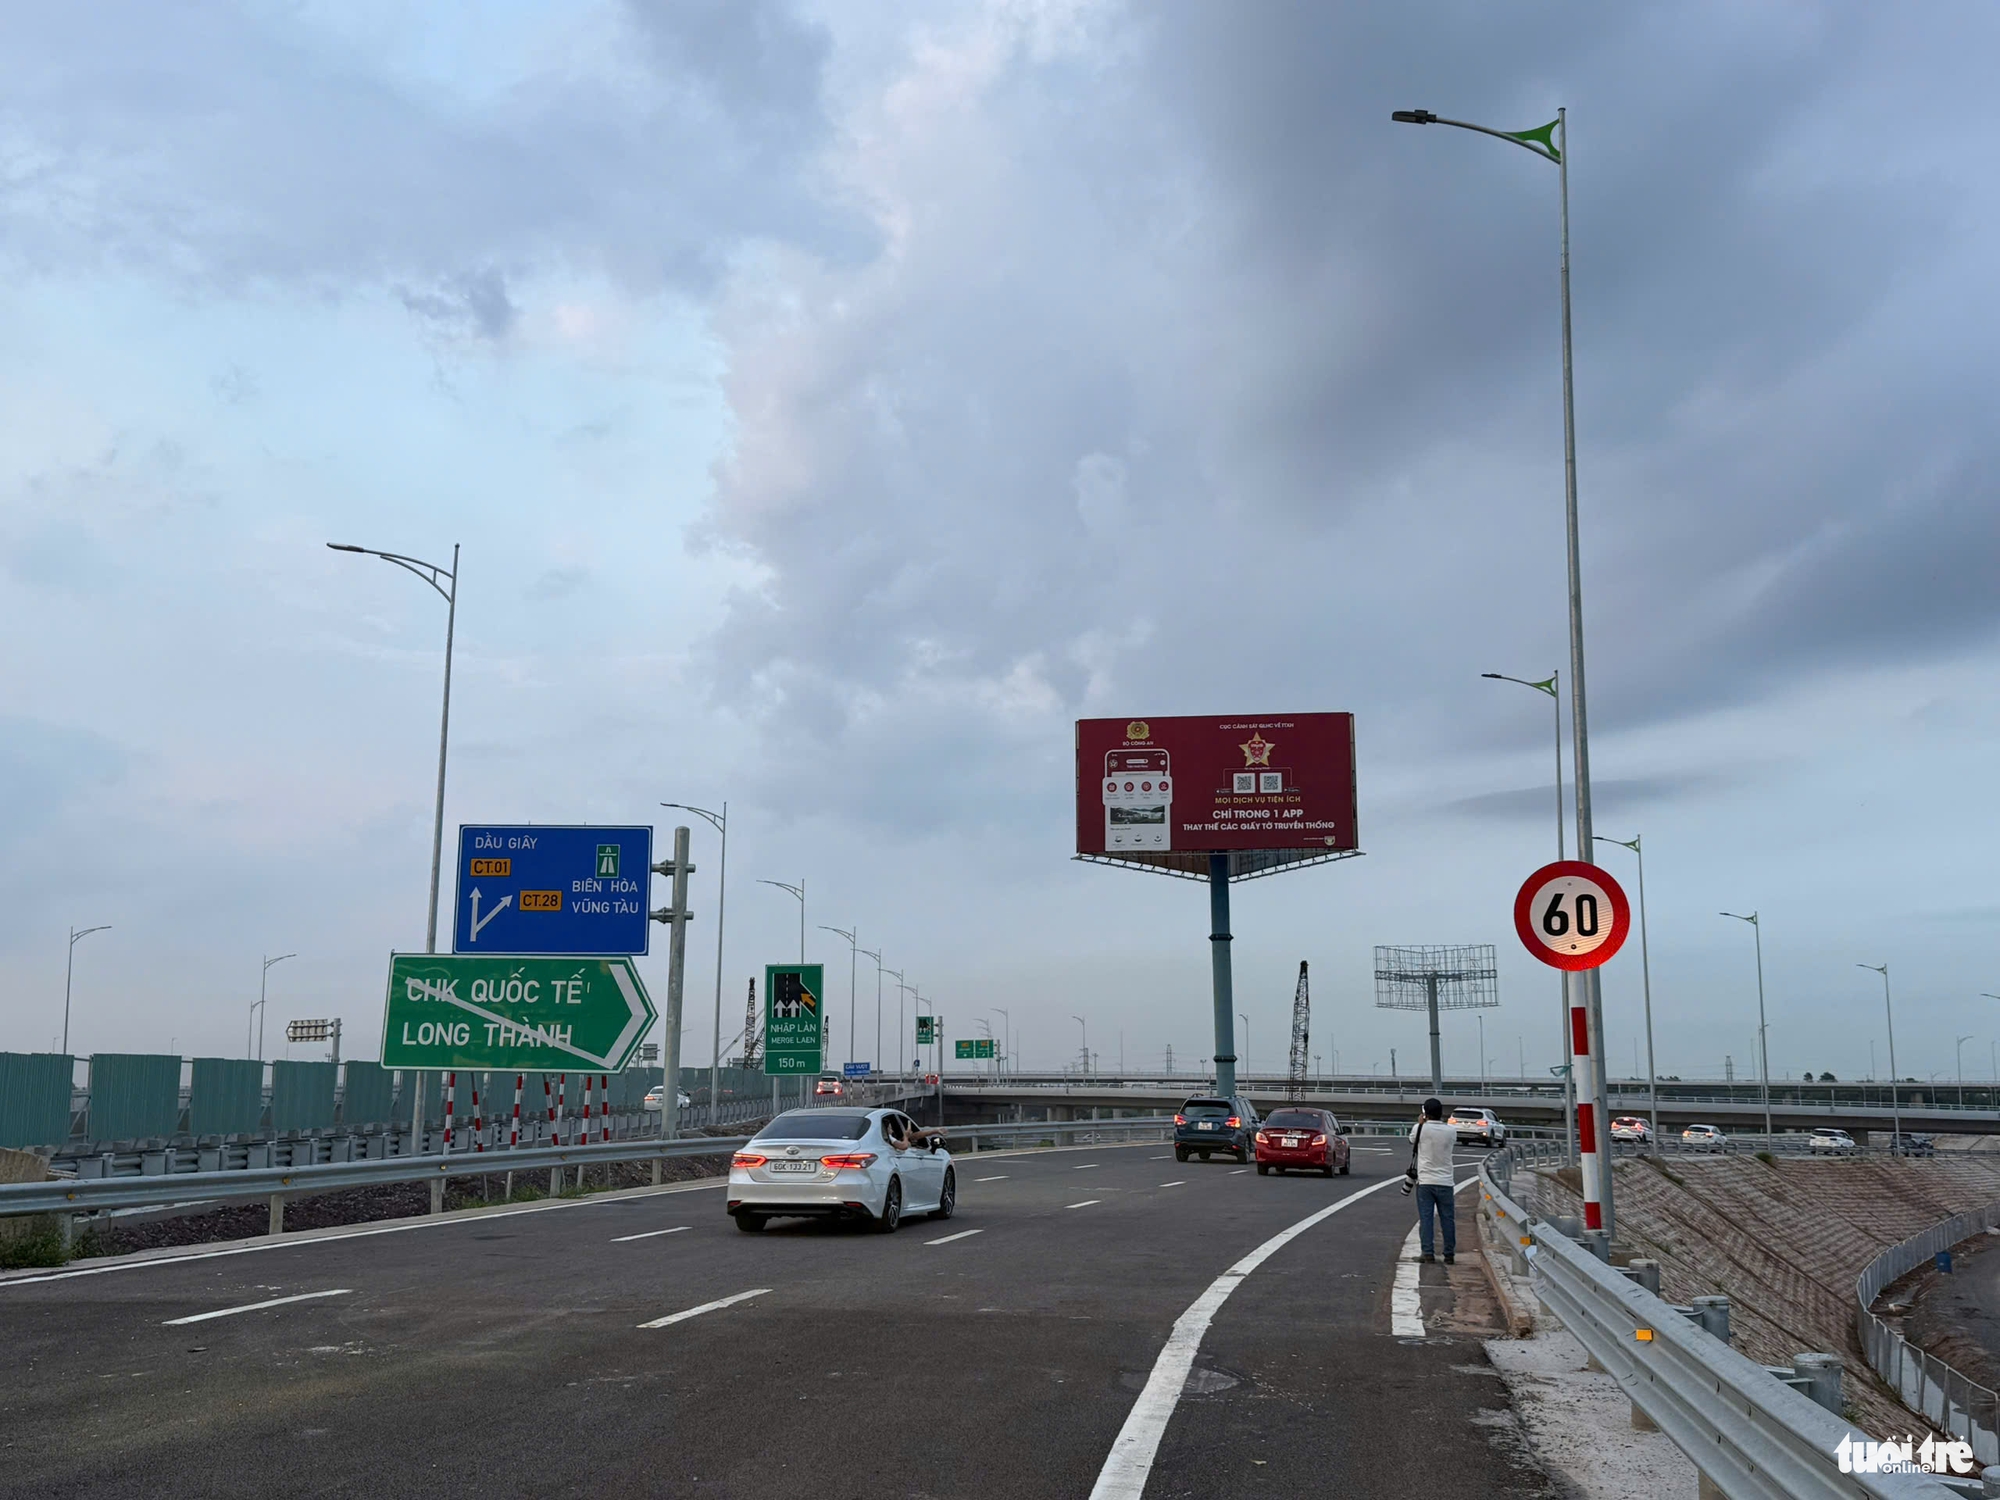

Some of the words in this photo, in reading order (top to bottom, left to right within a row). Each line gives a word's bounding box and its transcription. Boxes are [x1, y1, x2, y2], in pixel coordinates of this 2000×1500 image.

[1215, 796, 1231, 805] MỌI
[1233, 796, 1253, 805] DỊCH
[1255, 796, 1266, 805] VỤ
[1267, 795, 1284, 804] TIỆN
[1286, 795, 1301, 803] ÍCH
[1212, 808, 1232, 819] CHỈ
[1233, 809, 1271, 819] TRONG
[1273, 809, 1279, 818] 1
[1282, 808, 1304, 818] APP
[1182, 823, 1203, 831] THAY
[1204, 821, 1219, 831] THẾ
[1220, 821, 1239, 831] CÁC
[1240, 821, 1260, 831] GIẤY
[1261, 821, 1273, 830] TỜ
[1274, 820, 1304, 829] TRUYỀN
[1305, 819, 1336, 829] THỐNG
[474, 832, 503, 849] DẦU
[507, 834, 538, 850] GIÂY
[473, 860, 509, 874] CT.01
[572, 877, 602, 893] BIÊN
[610, 878, 639, 893] HÒA
[522, 893, 559, 907] CT.28
[571, 898, 610, 914] VŨNG
[612, 898, 639, 914] TÀU
[1542, 893, 1599, 937] 60
[406, 977, 460, 1002] CHK
[470, 967, 541, 1003] QUỐC
[550, 968, 587, 1004] TẾ
[401, 1021, 471, 1046] LONG
[483, 1016, 573, 1047] THÀNH
[770, 1022, 796, 1034] NHẬP
[796, 1021, 817, 1033] LÀN
[771, 1036, 795, 1045] MERGE
[796, 1036, 816, 1044] LAEN
[778, 1057, 795, 1068] 150
